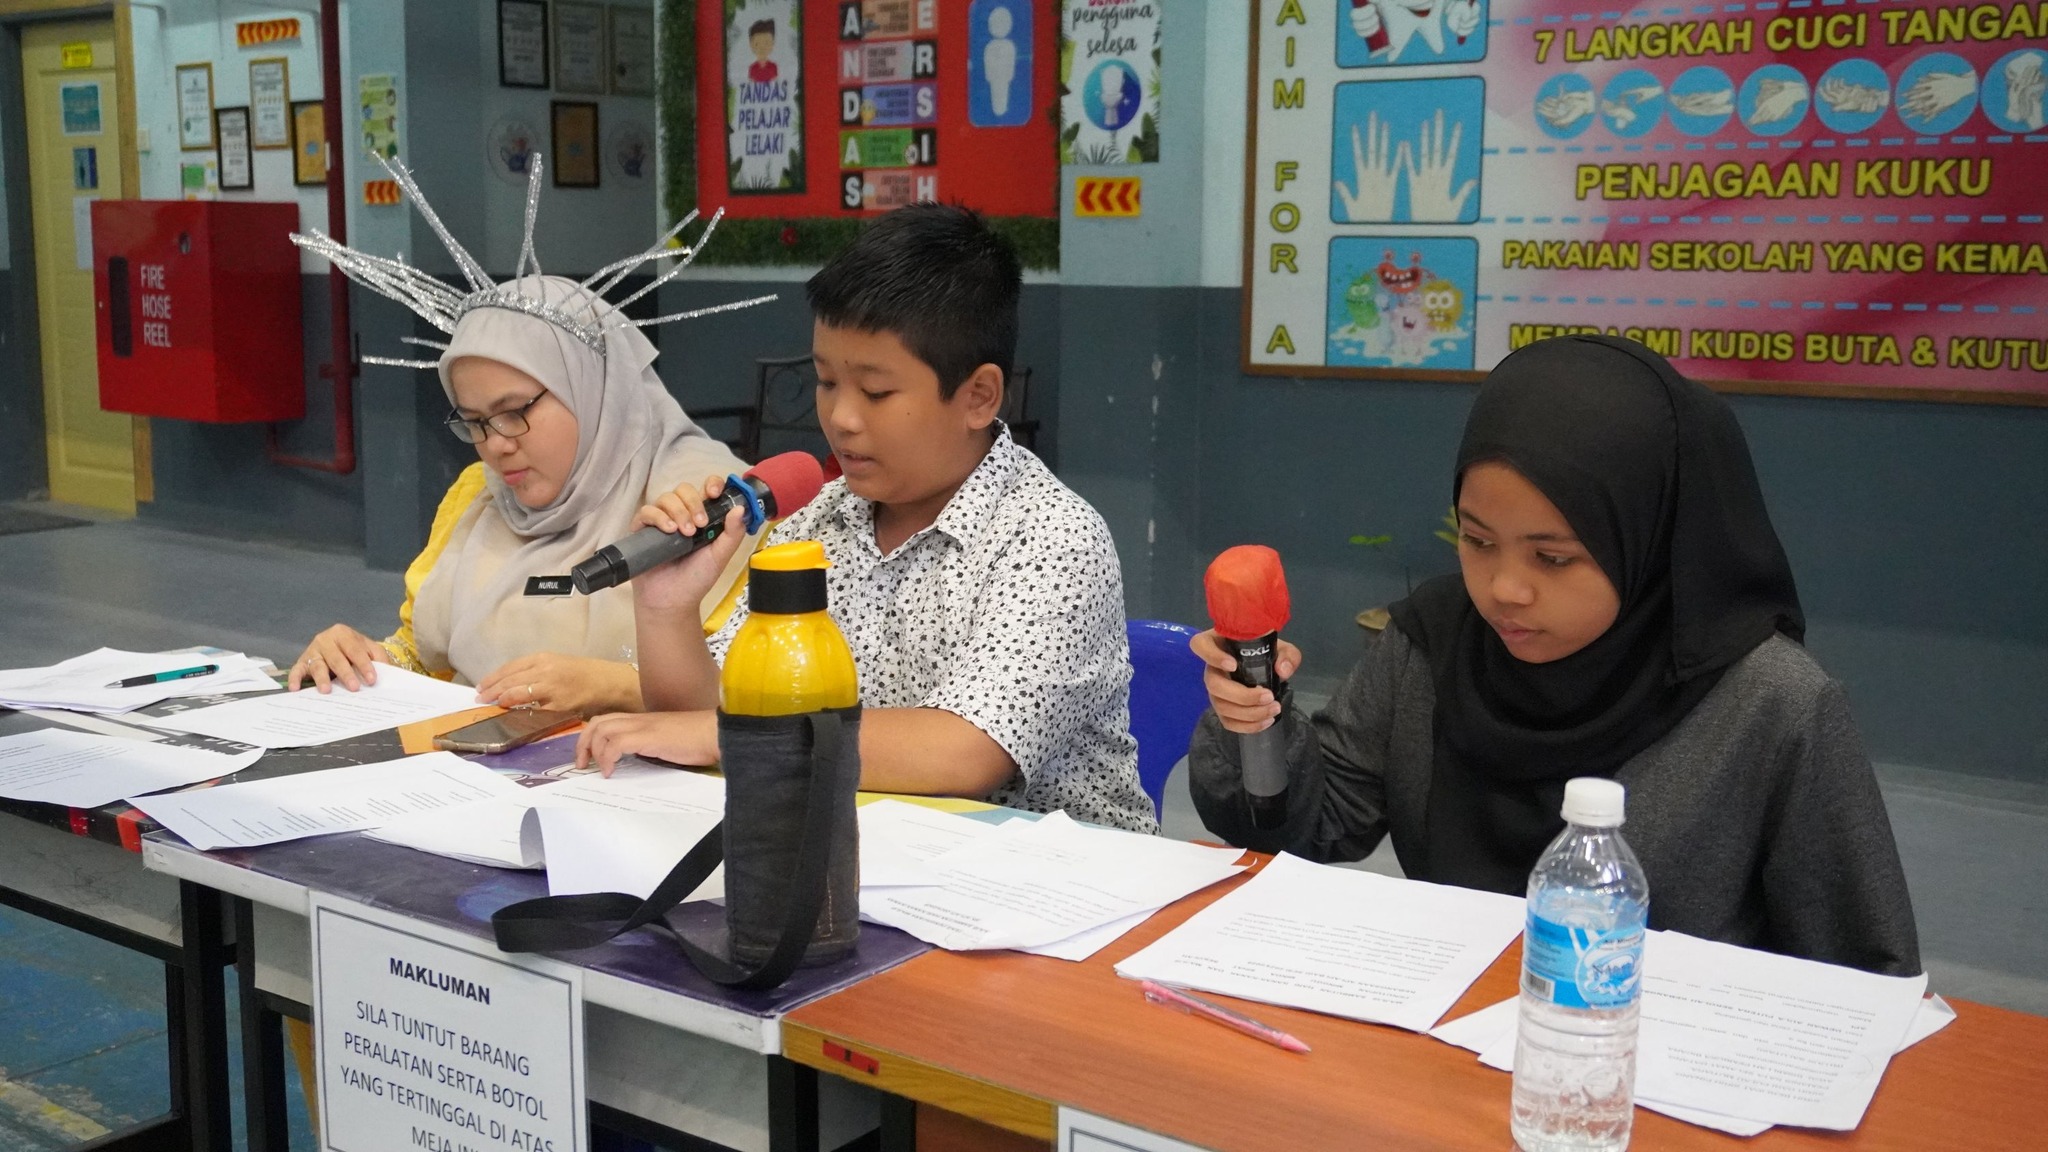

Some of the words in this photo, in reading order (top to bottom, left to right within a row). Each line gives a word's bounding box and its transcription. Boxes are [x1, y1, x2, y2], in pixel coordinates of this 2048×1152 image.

[1071, 4, 1154, 31] pengguna
[1086, 28, 1139, 58] selesa
[1534, 31, 1555, 63] 7
[1564, 20, 1752, 63] LANGKAH
[1766, 12, 1866, 51] CUCI
[739, 79, 789, 105] TANDAS
[738, 106, 792, 131] PELAJAR
[745, 133, 785, 157] LELAKI
[1576, 160, 1839, 200] PENJAGAAN
[1856, 158, 1993, 196] KUKU
[1502, 240, 1640, 270] PAKAIAN
[1649, 241, 1813, 273] SEKOLAH
[1823, 242, 1925, 274] YANG
[140, 265, 165, 290] FIRE
[142, 295, 171, 319] HOSE
[144, 323, 172, 347] REEL
[1265, 324, 1296, 355] A
[1690, 330, 1795, 362] KUDIS
[1805, 334, 1901, 366] BUTA
[1910, 335, 1938, 368] &
[1949, 336, 2048, 372] KUTU
[537, 581, 559, 590] NURUL
[389, 957, 490, 1006] MAKLUMAN
[356, 1000, 389, 1029] SILA
[391, 1011, 456, 1051] TUNTUT
[460, 1035, 530, 1077] BARANG
[344, 1031, 433, 1079] PERALATAN
[436, 1063, 488, 1099] SERTA
[491, 1083, 548, 1121] BOTOL
[340, 1064, 383, 1097] YANG
[387, 1081, 486, 1136] TERTINGGAL
[490, 1119, 507, 1144] DI
